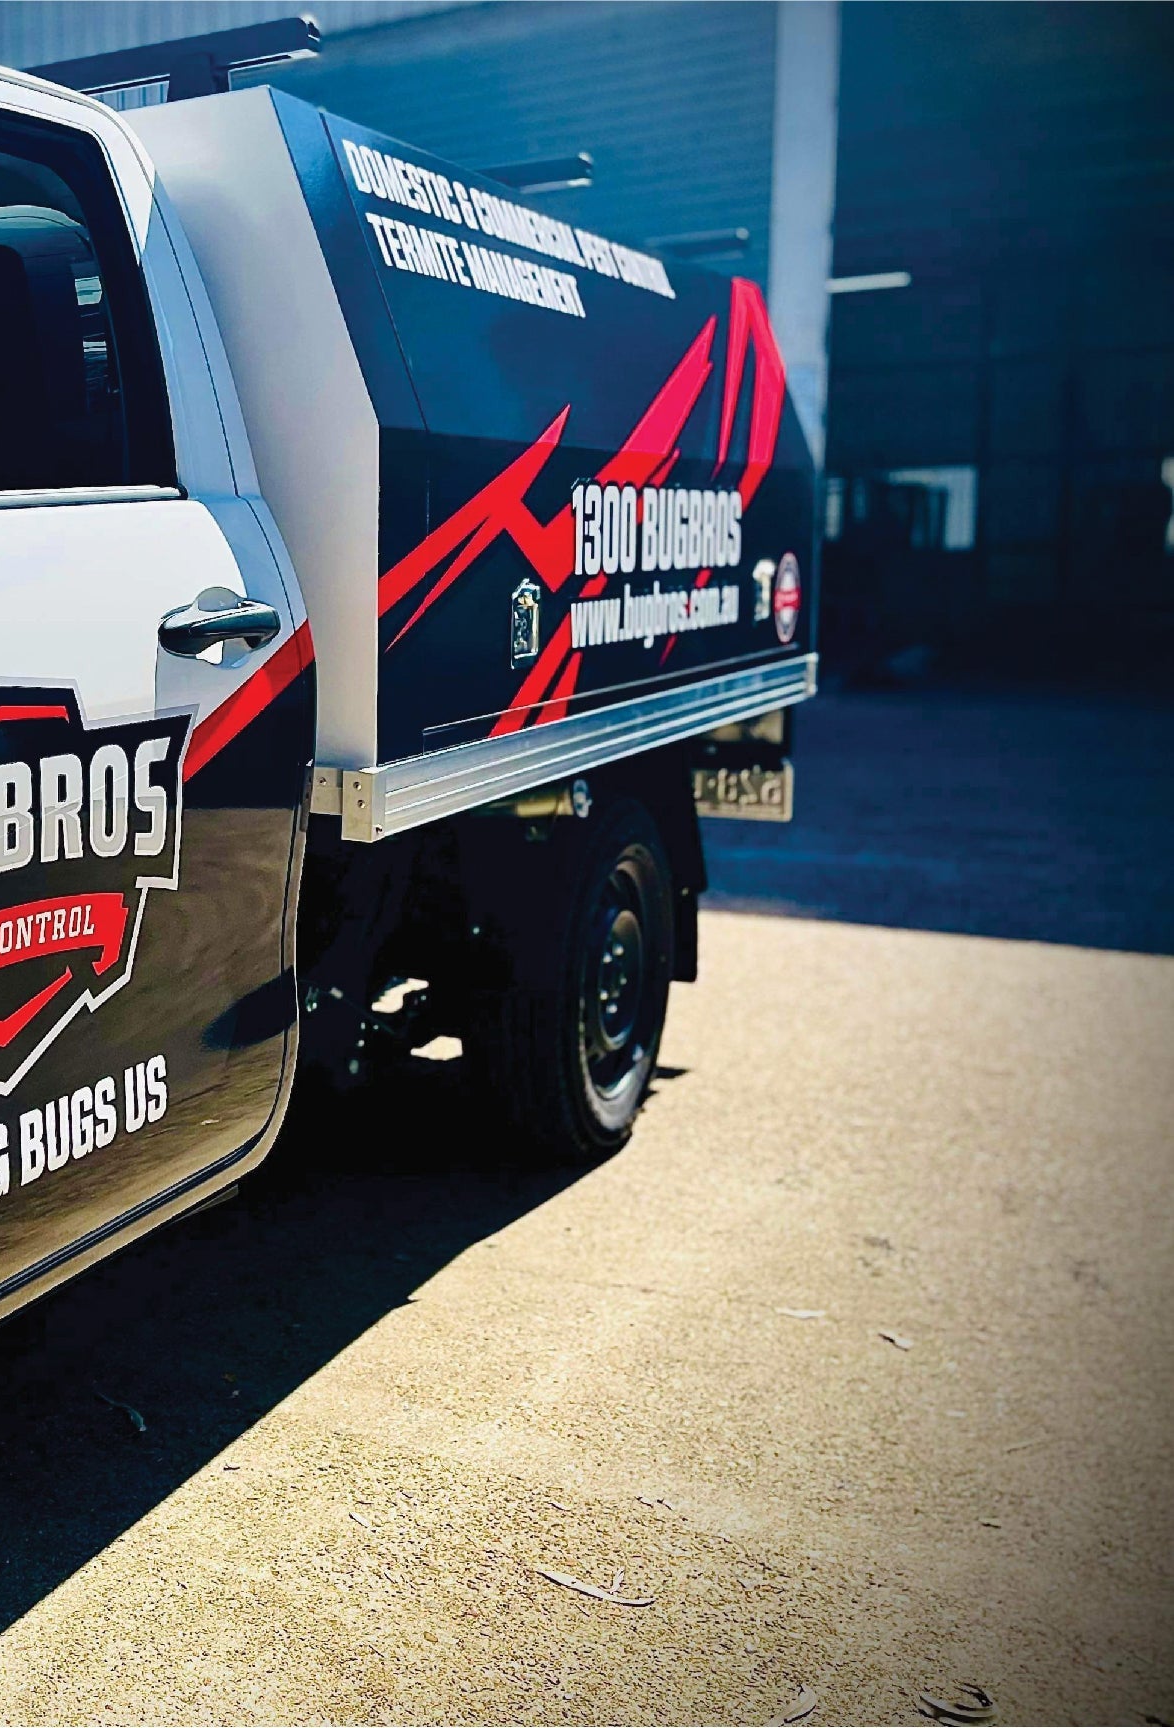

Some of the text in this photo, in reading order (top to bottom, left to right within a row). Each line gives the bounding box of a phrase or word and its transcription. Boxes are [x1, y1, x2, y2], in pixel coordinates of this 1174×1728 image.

[342, 139, 462, 225] DOMESTIC
[452, 181, 479, 230] &
[469, 187, 586, 268] COMMERCIAL
[366, 212, 586, 318] TERMITE MANAGEMENT
[571, 484, 742, 576] 1300 BUGBROS
[570, 581, 740, 649] www.bugbros.com.au
[20, 1075, 117, 1187] BUGS
[124, 1054, 168, 1134] US
